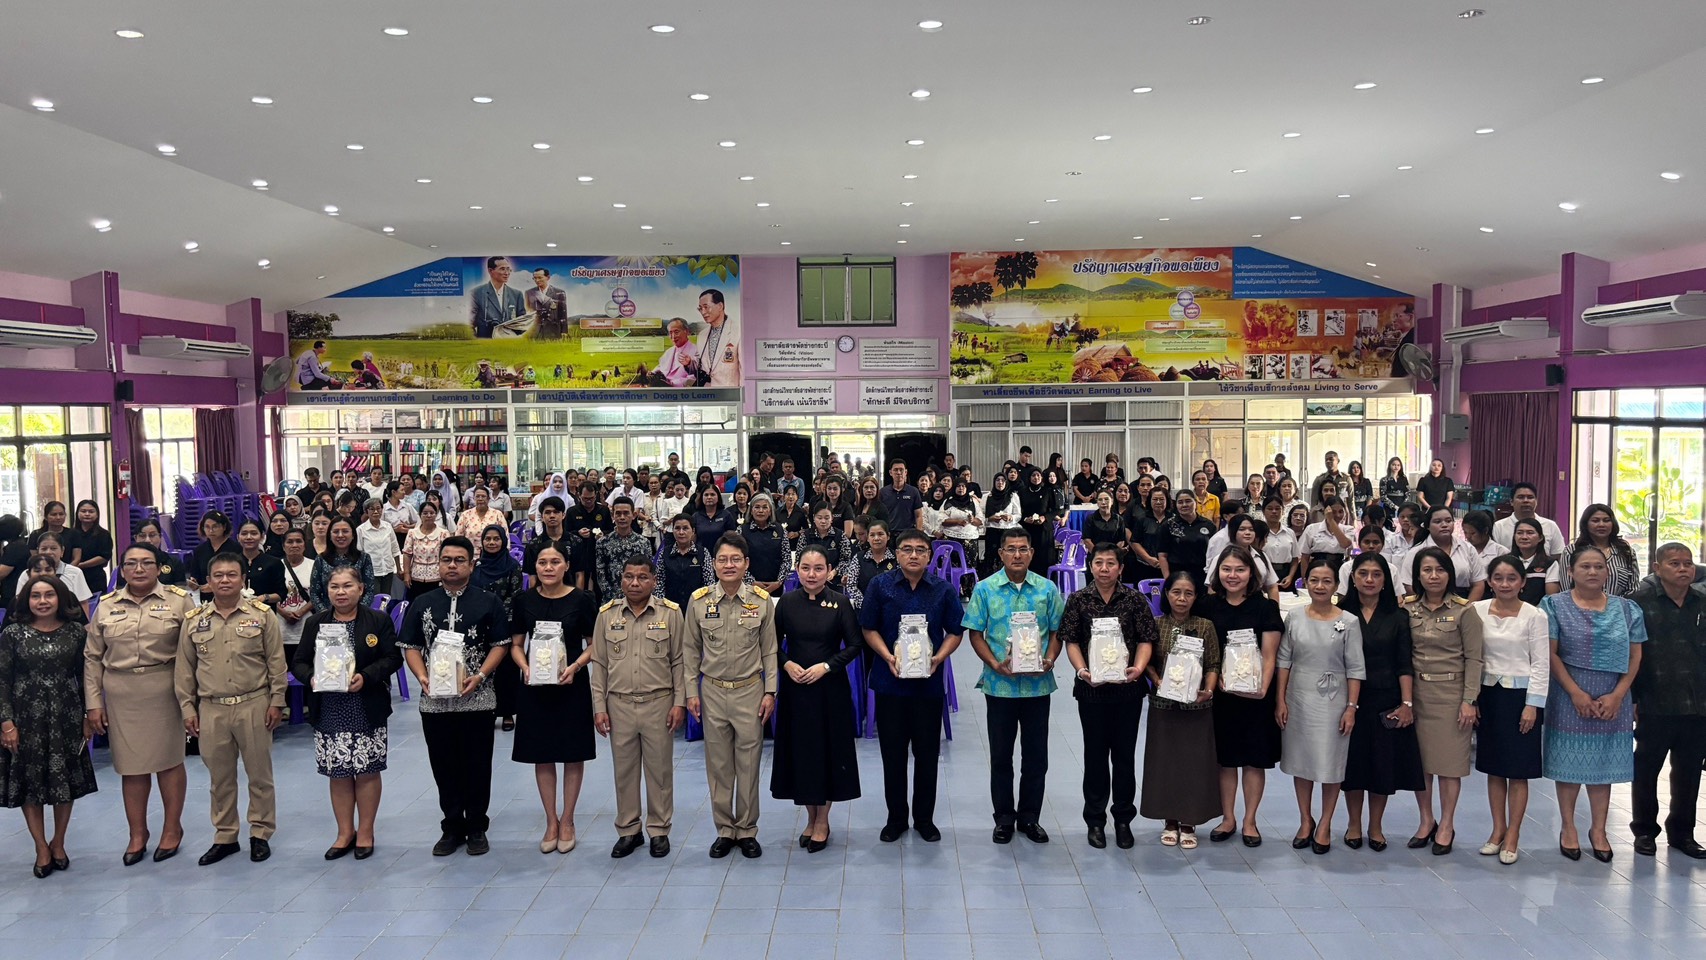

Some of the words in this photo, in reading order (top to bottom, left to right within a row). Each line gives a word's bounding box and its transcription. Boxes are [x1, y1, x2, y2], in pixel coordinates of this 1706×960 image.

[1073, 256, 1220, 276] ปรัชญาเศรษฐกิจพอเพียง
[571, 265, 666, 279] ปรัชญาเศรษฐกิจพอเพียง
[763, 341, 829, 349] วิทยาลัยสารพัดช่างกระบี่
[1088, 386, 1121, 395] Earning
[1218, 382, 1311, 392] ใช้วิชาเพื่อบริการสังคม
[1314, 383, 1340, 392] Living
[1354, 383, 1378, 391] Serve
[431, 394, 468, 402] Learning
[653, 392, 678, 400] Doing
